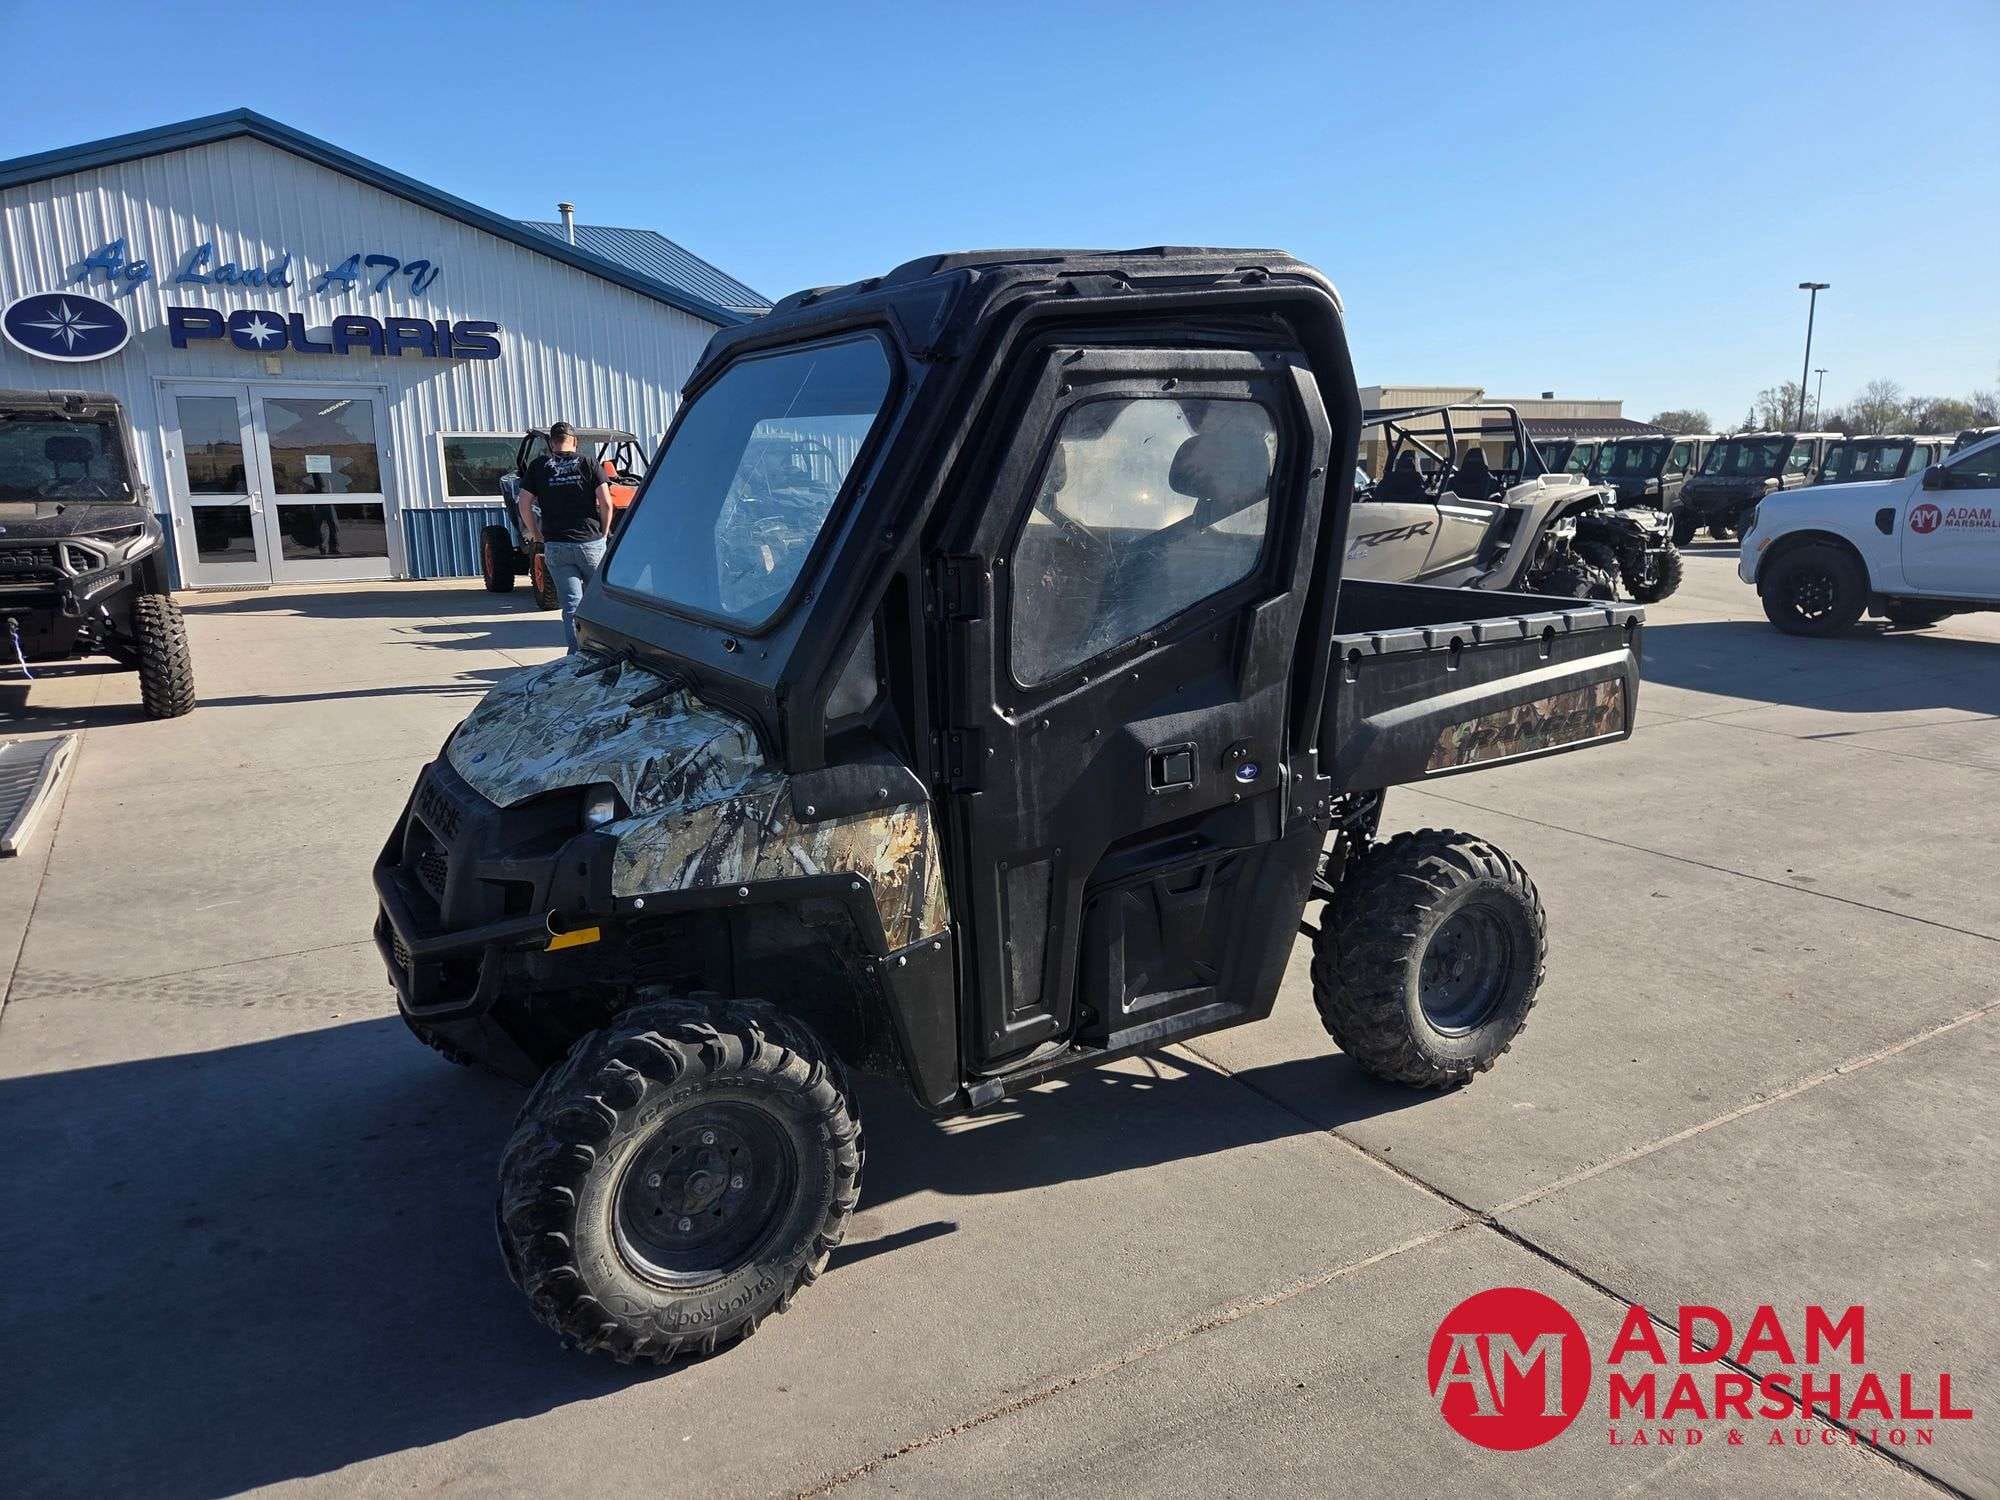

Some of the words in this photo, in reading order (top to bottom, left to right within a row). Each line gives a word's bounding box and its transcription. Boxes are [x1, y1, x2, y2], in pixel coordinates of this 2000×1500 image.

[77, 237, 152, 296] Ag
[175, 241, 294, 289] Land
[316, 253, 440, 297] ATV
[167, 306, 502, 360] POLARIS
[1945, 519, 2000, 528] MARSHAL
[1946, 508, 1992, 520] ADAM
[1347, 521, 1434, 554] RZR
